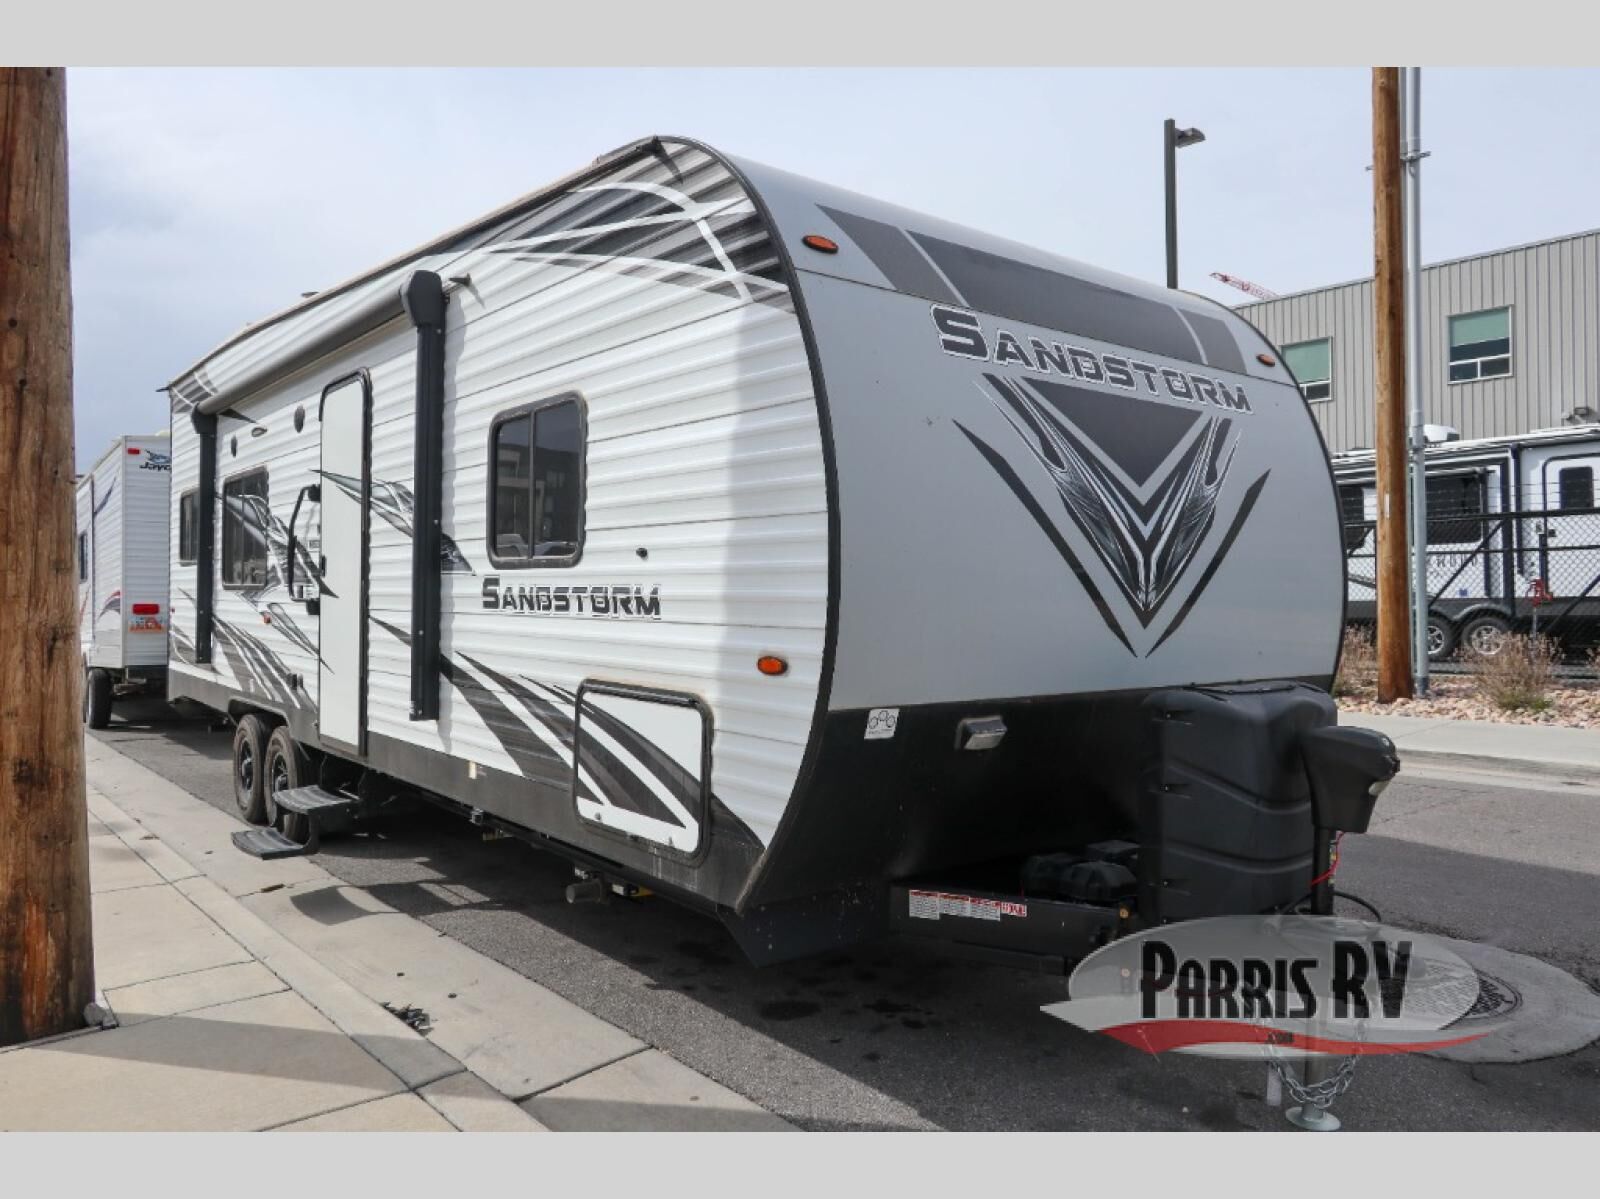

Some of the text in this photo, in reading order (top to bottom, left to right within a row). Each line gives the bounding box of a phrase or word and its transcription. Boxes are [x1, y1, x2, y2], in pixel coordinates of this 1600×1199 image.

[930, 303, 1252, 413] SANDSTORM
[139, 461, 171, 472] Jayc
[482, 574, 662, 620] SANDSTORM
